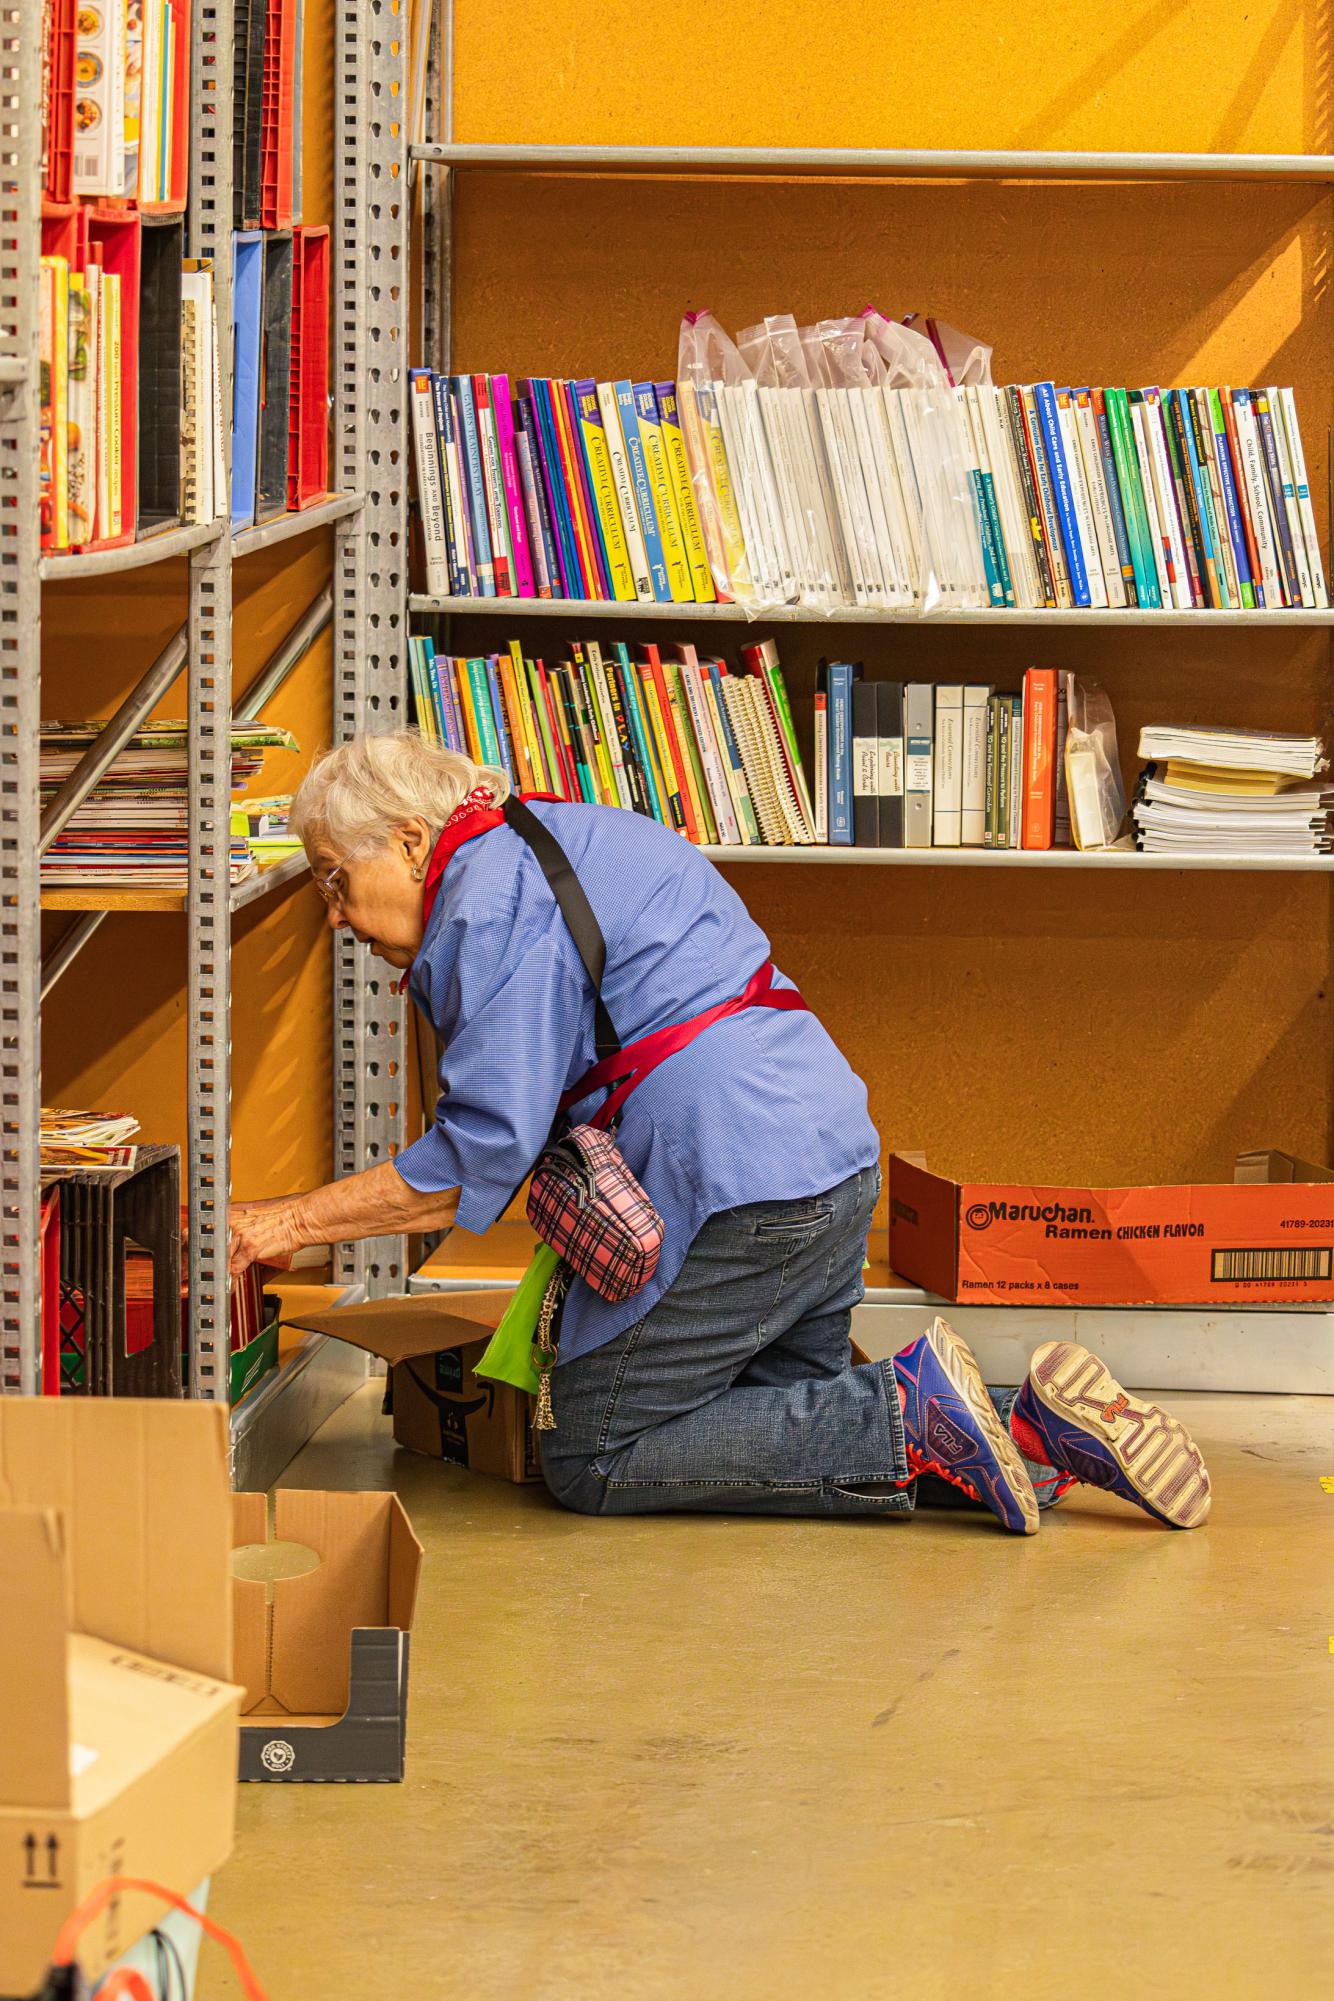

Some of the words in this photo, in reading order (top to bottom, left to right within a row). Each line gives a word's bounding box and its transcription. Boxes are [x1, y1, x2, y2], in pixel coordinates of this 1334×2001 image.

[1041, 388, 1050, 398] All
[463, 394, 475, 426] GAMES
[1044, 399, 1053, 418] About
[1030, 417, 1041, 446] Curriculum
[1048, 419, 1057, 436] Child
[467, 430, 480, 474] TRAINERS
[1035, 447, 1045, 463] Guide
[1050, 437, 1059, 450] Care
[1104, 440, 1113, 458] WEEK
[1217, 437, 1226, 461] PLANNING
[1245, 439, 1255, 458] Child,
[424, 433, 437, 486] Beginnings
[613, 452, 626, 485] CREATIVE
[1053, 452, 1061, 464] and
[974, 471, 983, 487] Caring
[1040, 474, 1048, 487] Early
[1055, 465, 1065, 480] Early
[1221, 462, 1230, 486] EFFECTIVE
[1248, 460, 1259, 484] Family,
[473, 477, 482, 498] PLAY
[591, 437, 608, 485] CREATIVE
[601, 486, 621, 550] CURRICULUM
[628, 437, 645, 479] CREATIVE
[637, 479, 656, 536] CURRICULUM
[649, 435, 666, 482] CREATIVE
[658, 484, 679, 548] CURRICULUM
[671, 438, 689, 485] CREATIVE
[680, 486, 702, 552] CURRICULUM
[1060, 481, 1072, 512] Education
[1252, 486, 1263, 510] School,
[619, 486, 637, 533] CURRICULUM
[1042, 488, 1053, 515] Childhood
[1225, 487, 1236, 517] INSTRUCTION
[430, 505, 442, 541] Beyond
[1046, 516, 1059, 552] Development
[1256, 511, 1269, 550] Community
[1301, 573, 1309, 589] naeyc
[1314, 573, 1323, 589] naeyc
[683, 674, 691, 686] ALIKE
[606, 667, 619, 702] Partners
[614, 715, 629, 751] PLAY
[973, 744, 982, 778] Connections
[988, 1202, 1092, 1223] Maruchan
[1045, 1224, 1112, 1240] Ramen
[1117, 1225, 1160, 1239] CHICKEN
[1163, 1223, 1205, 1238] FLAVOR
[962, 1280, 994, 1289] Ramen
[996, 1280, 1007, 1289] 12
[1008, 1280, 1035, 1291] packs
[1044, 1280, 1050, 1289] 8
[1053, 1281, 1080, 1290] cases
[933, 1424, 964, 1455] FILA
